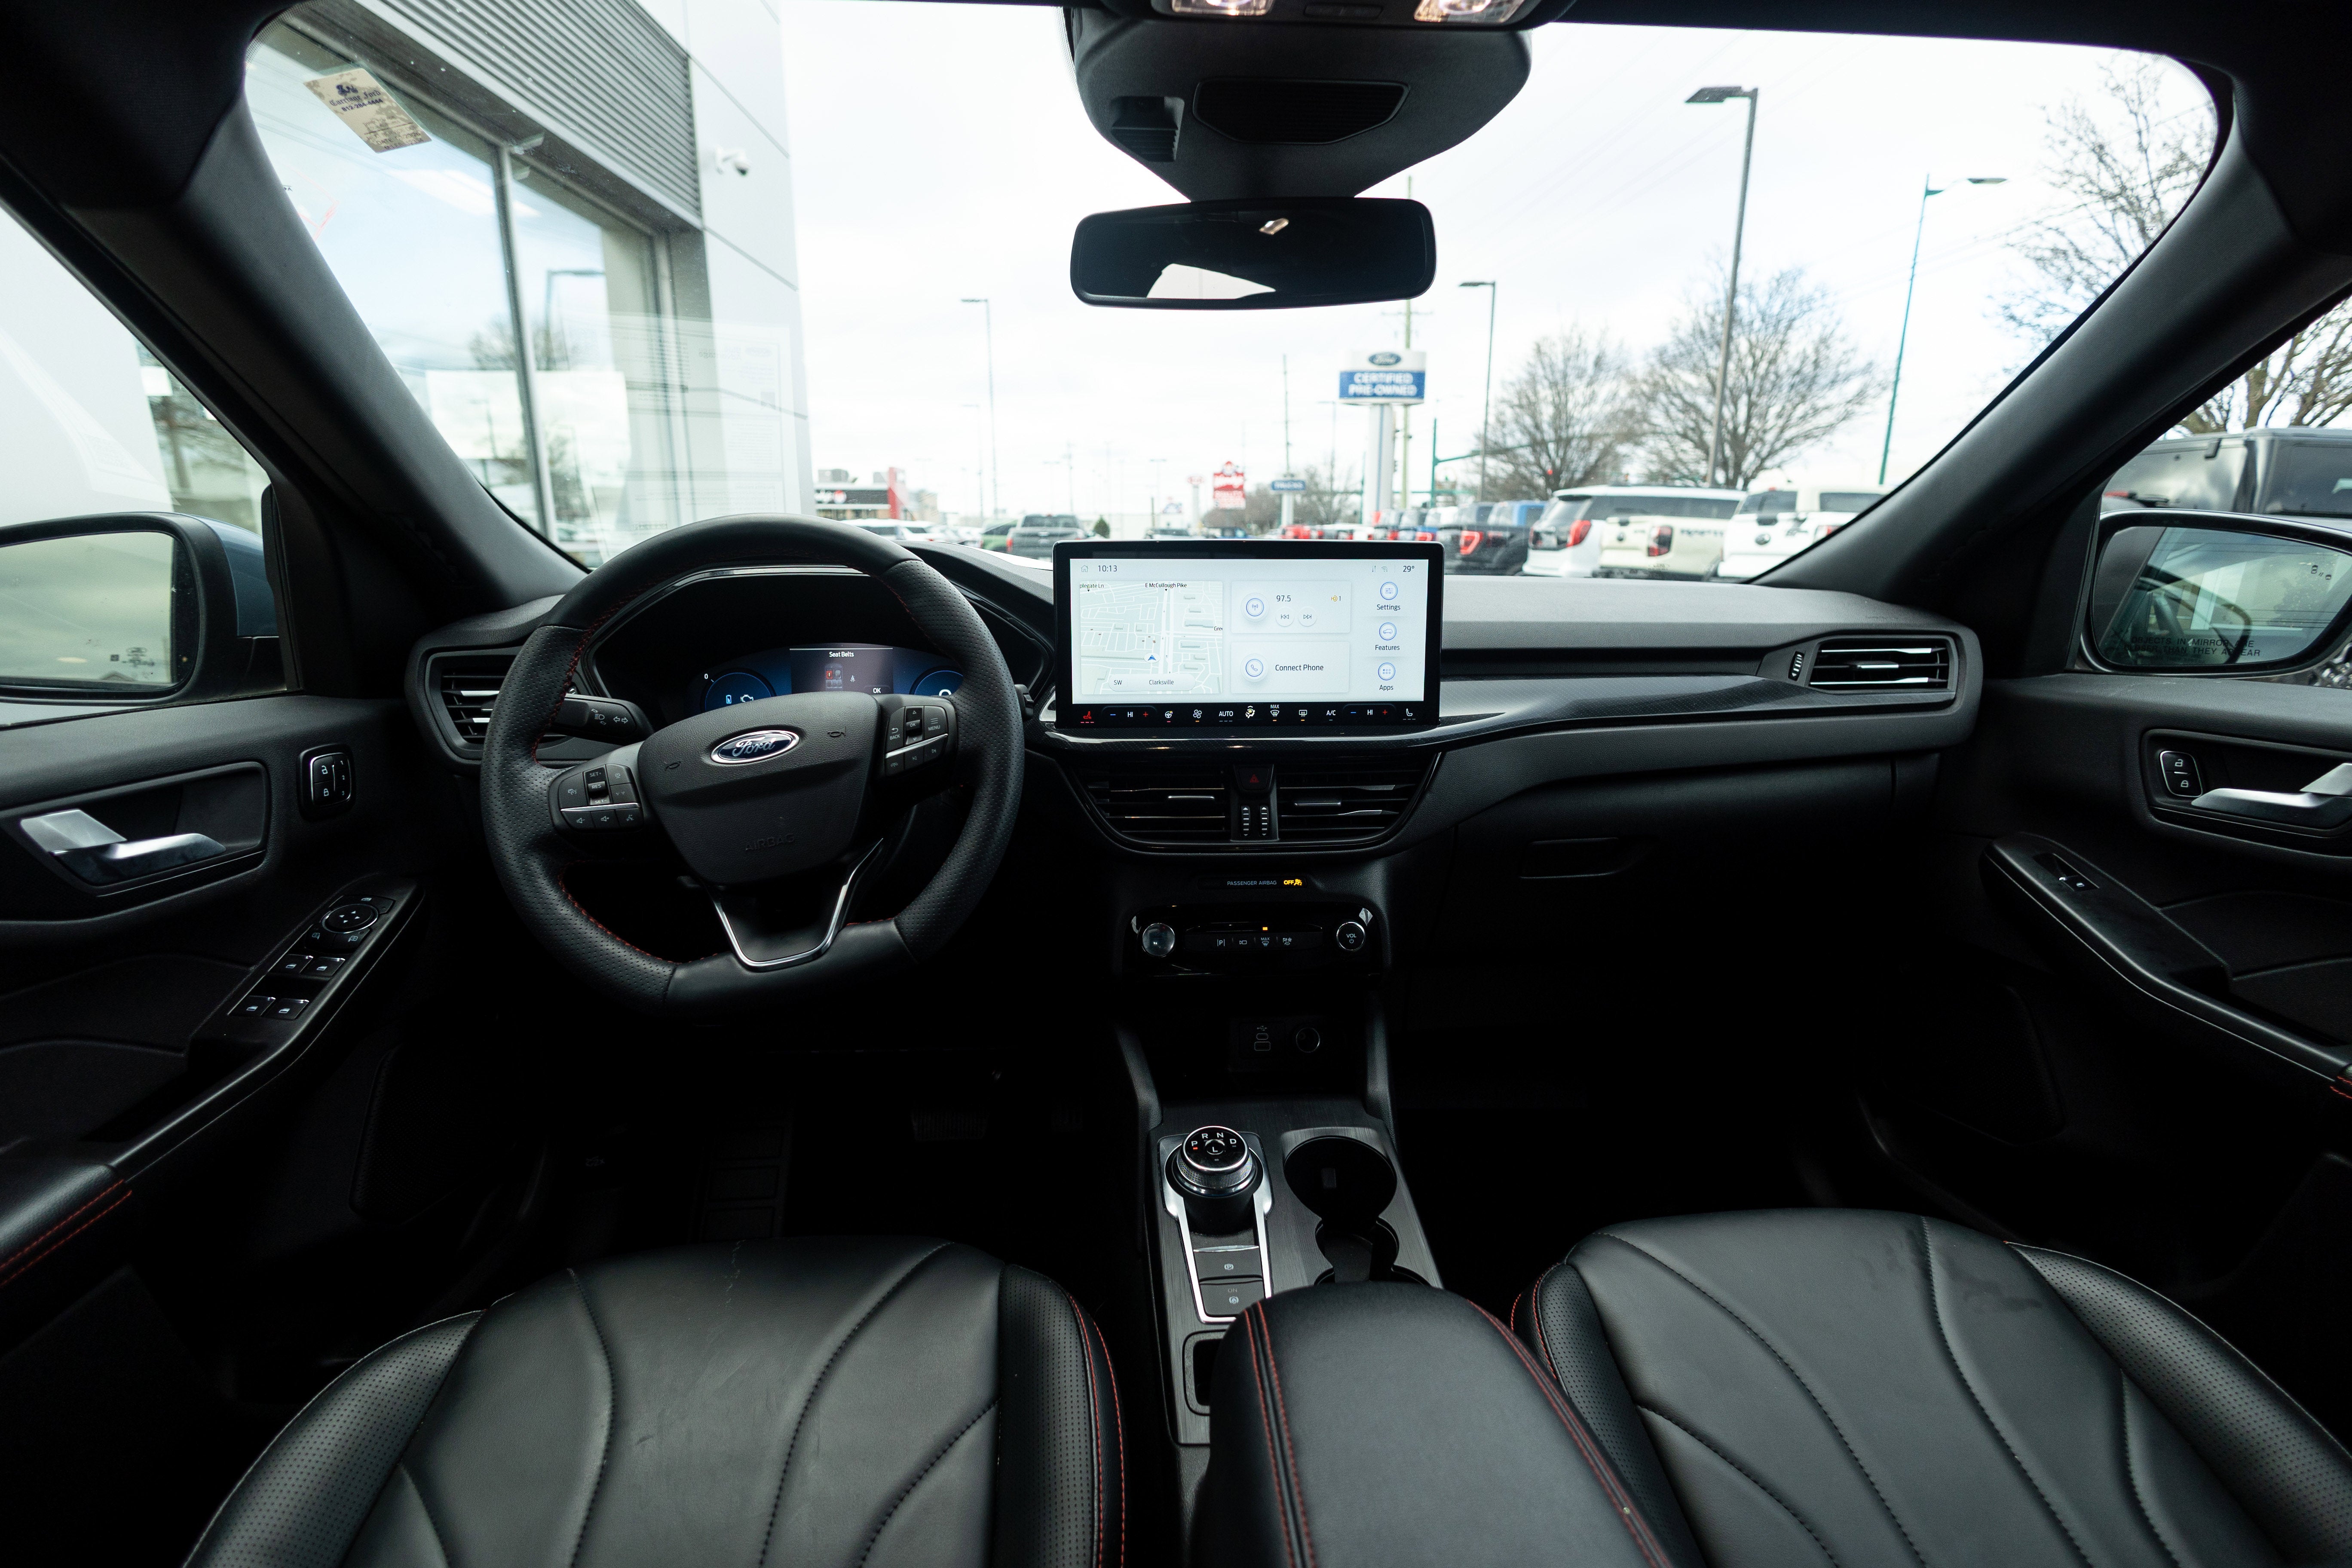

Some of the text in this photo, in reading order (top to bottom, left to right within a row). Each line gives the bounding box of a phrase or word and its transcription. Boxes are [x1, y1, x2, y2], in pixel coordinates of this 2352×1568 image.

[364, 89, 381, 99] Ford
[1354, 372, 1413, 383] CERTIFIED
[1348, 384, 1417, 396] PRE-OWNED
[732, 736, 777, 756] Ford
